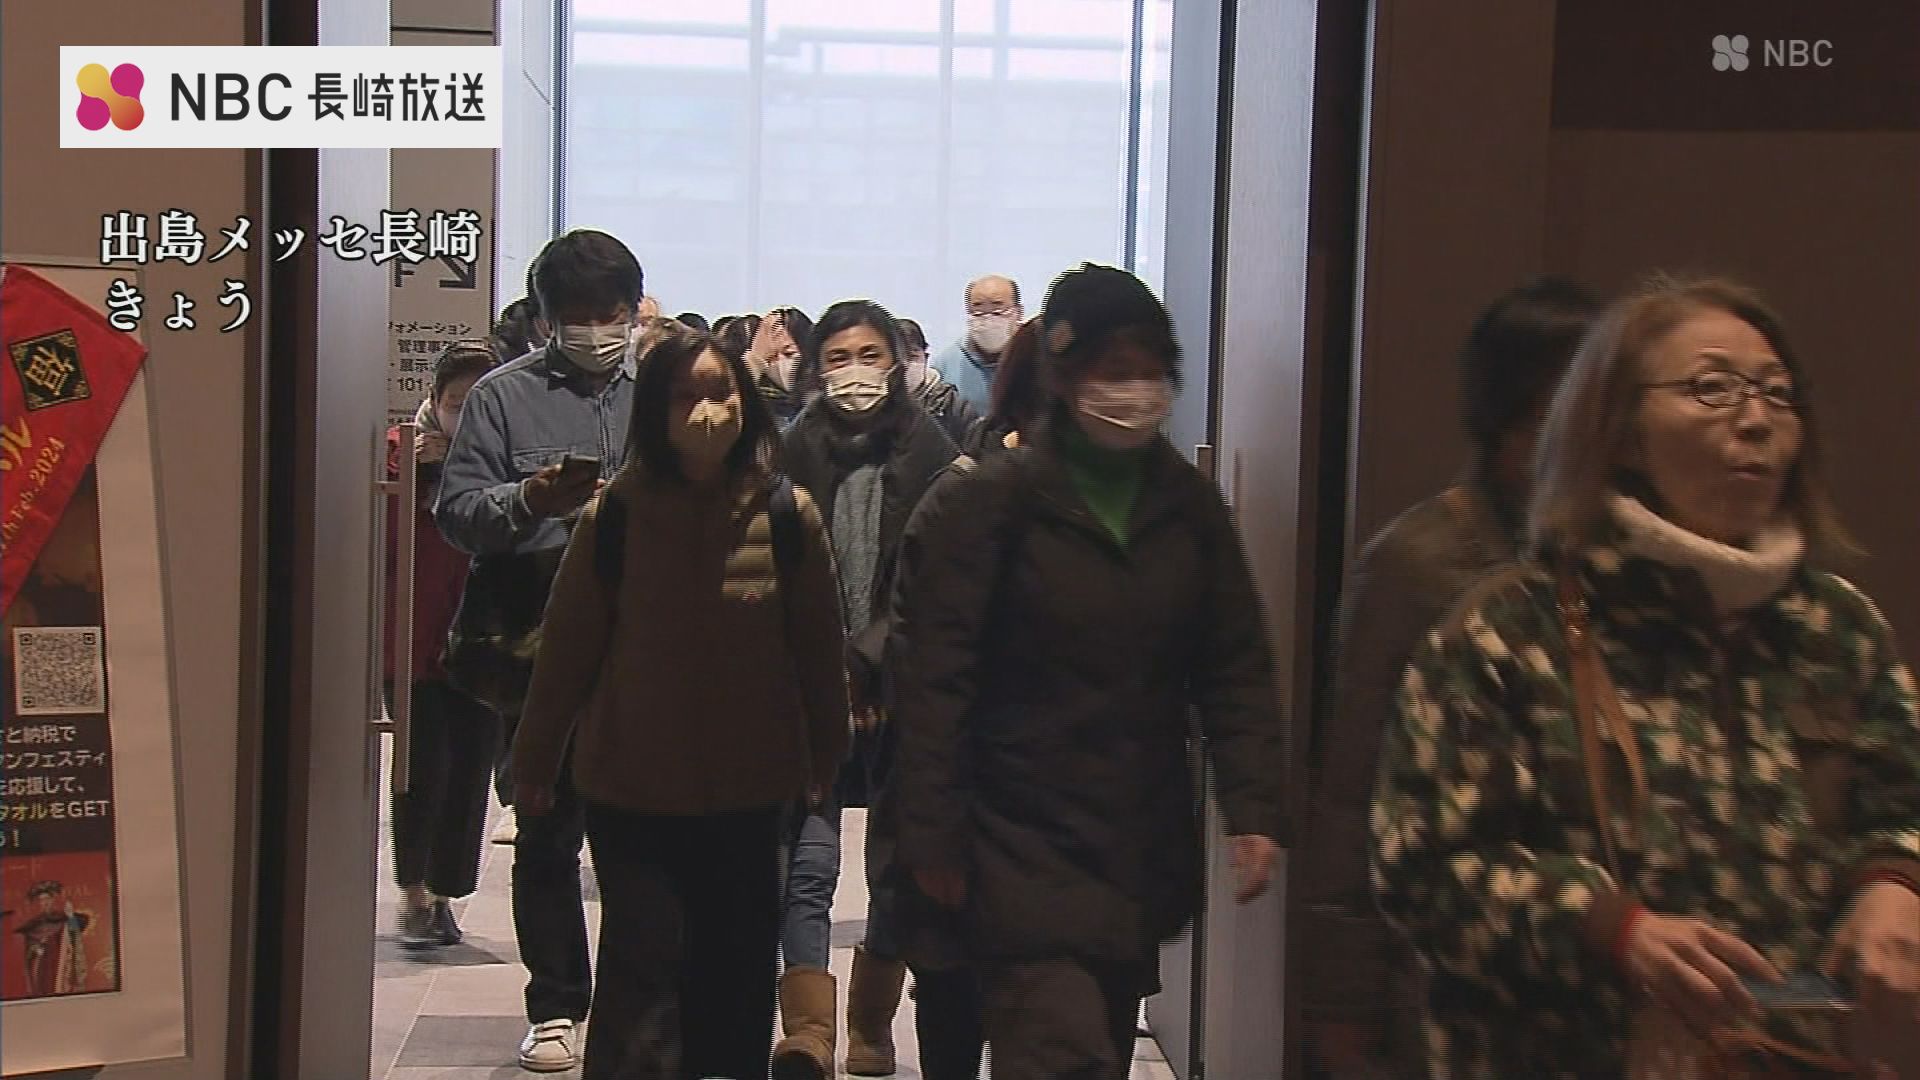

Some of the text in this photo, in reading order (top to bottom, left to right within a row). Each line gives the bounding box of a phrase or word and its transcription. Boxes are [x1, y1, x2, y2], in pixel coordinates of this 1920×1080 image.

[0, 724, 77, 744] と納税で
[0, 749, 105, 769] ンフェスティ
